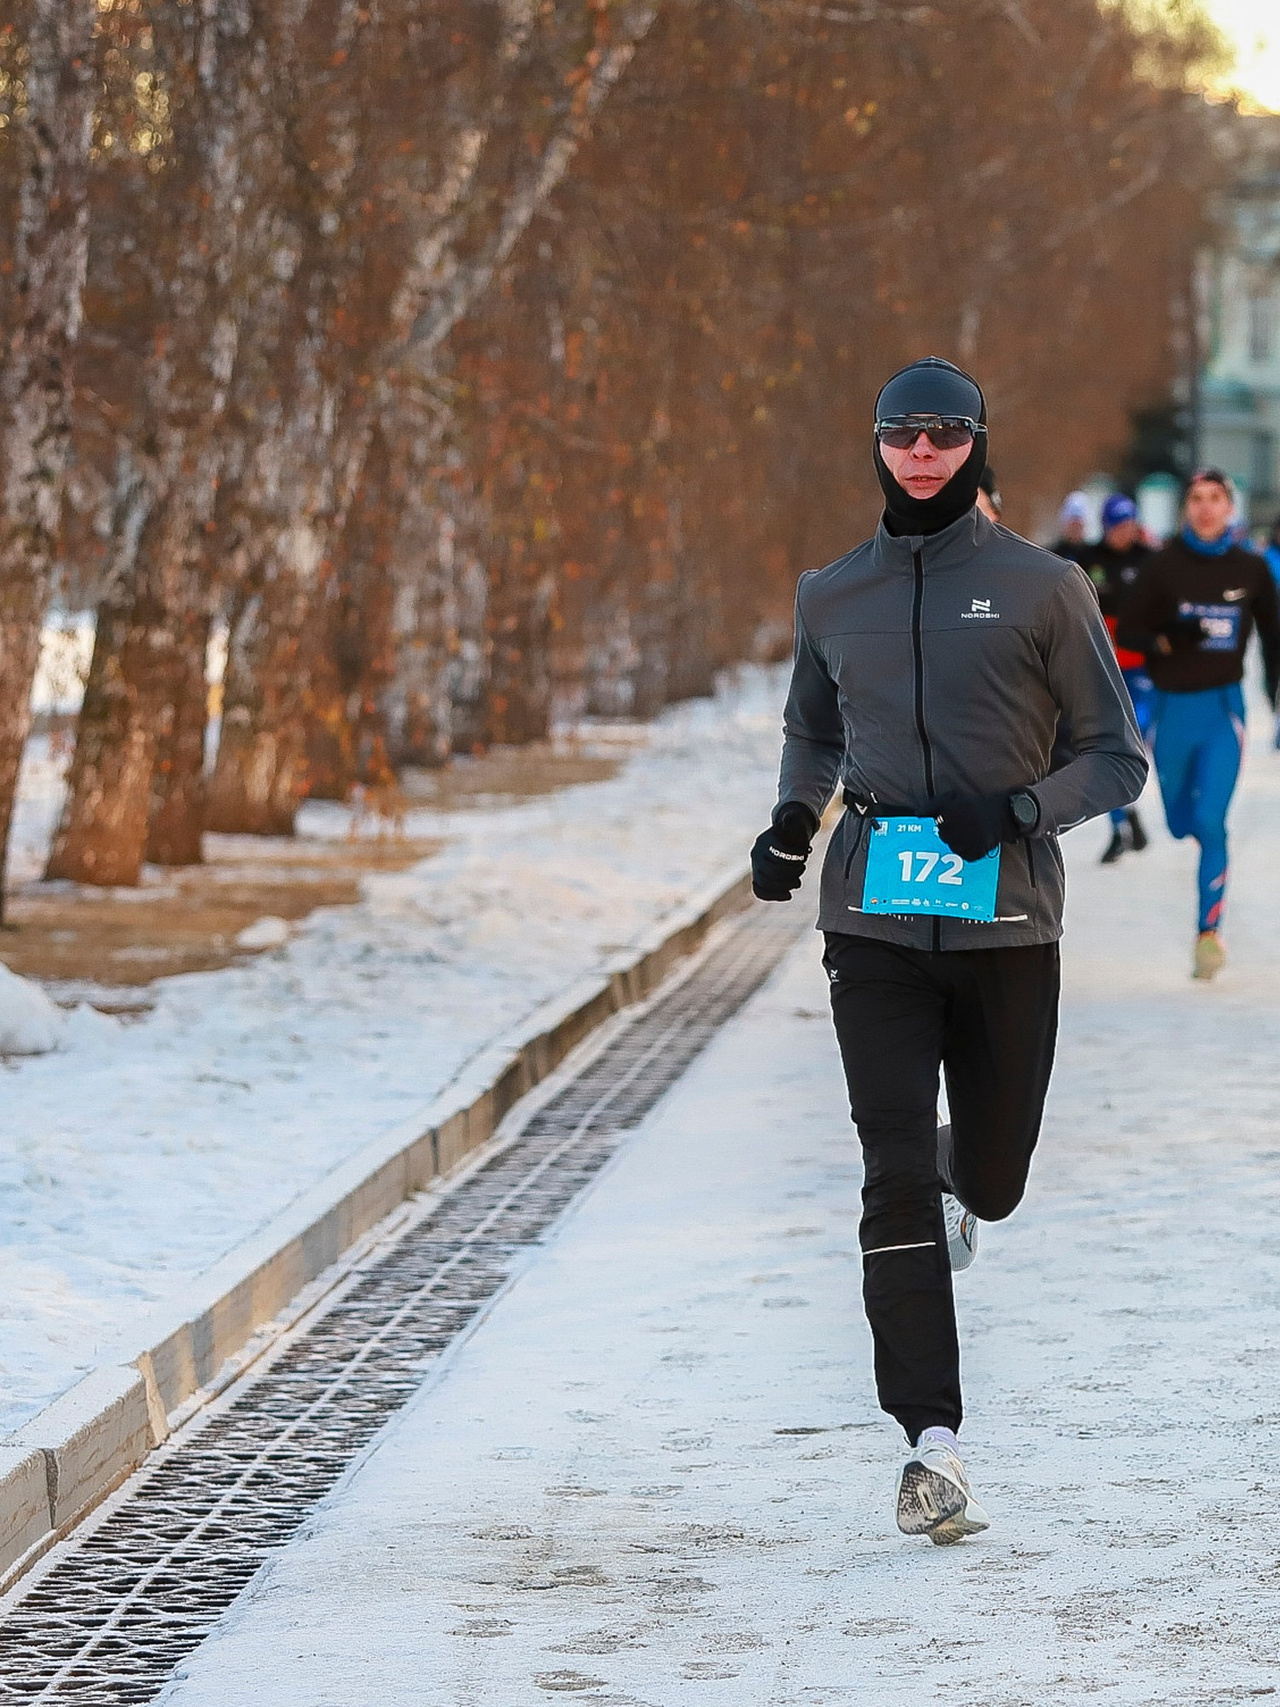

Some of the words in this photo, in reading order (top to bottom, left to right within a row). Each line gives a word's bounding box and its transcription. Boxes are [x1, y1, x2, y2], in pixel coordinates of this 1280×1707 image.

[897, 824, 906, 832] 21
[768, 845, 805, 861] NORDSKI
[898, 851, 964, 886] 172
